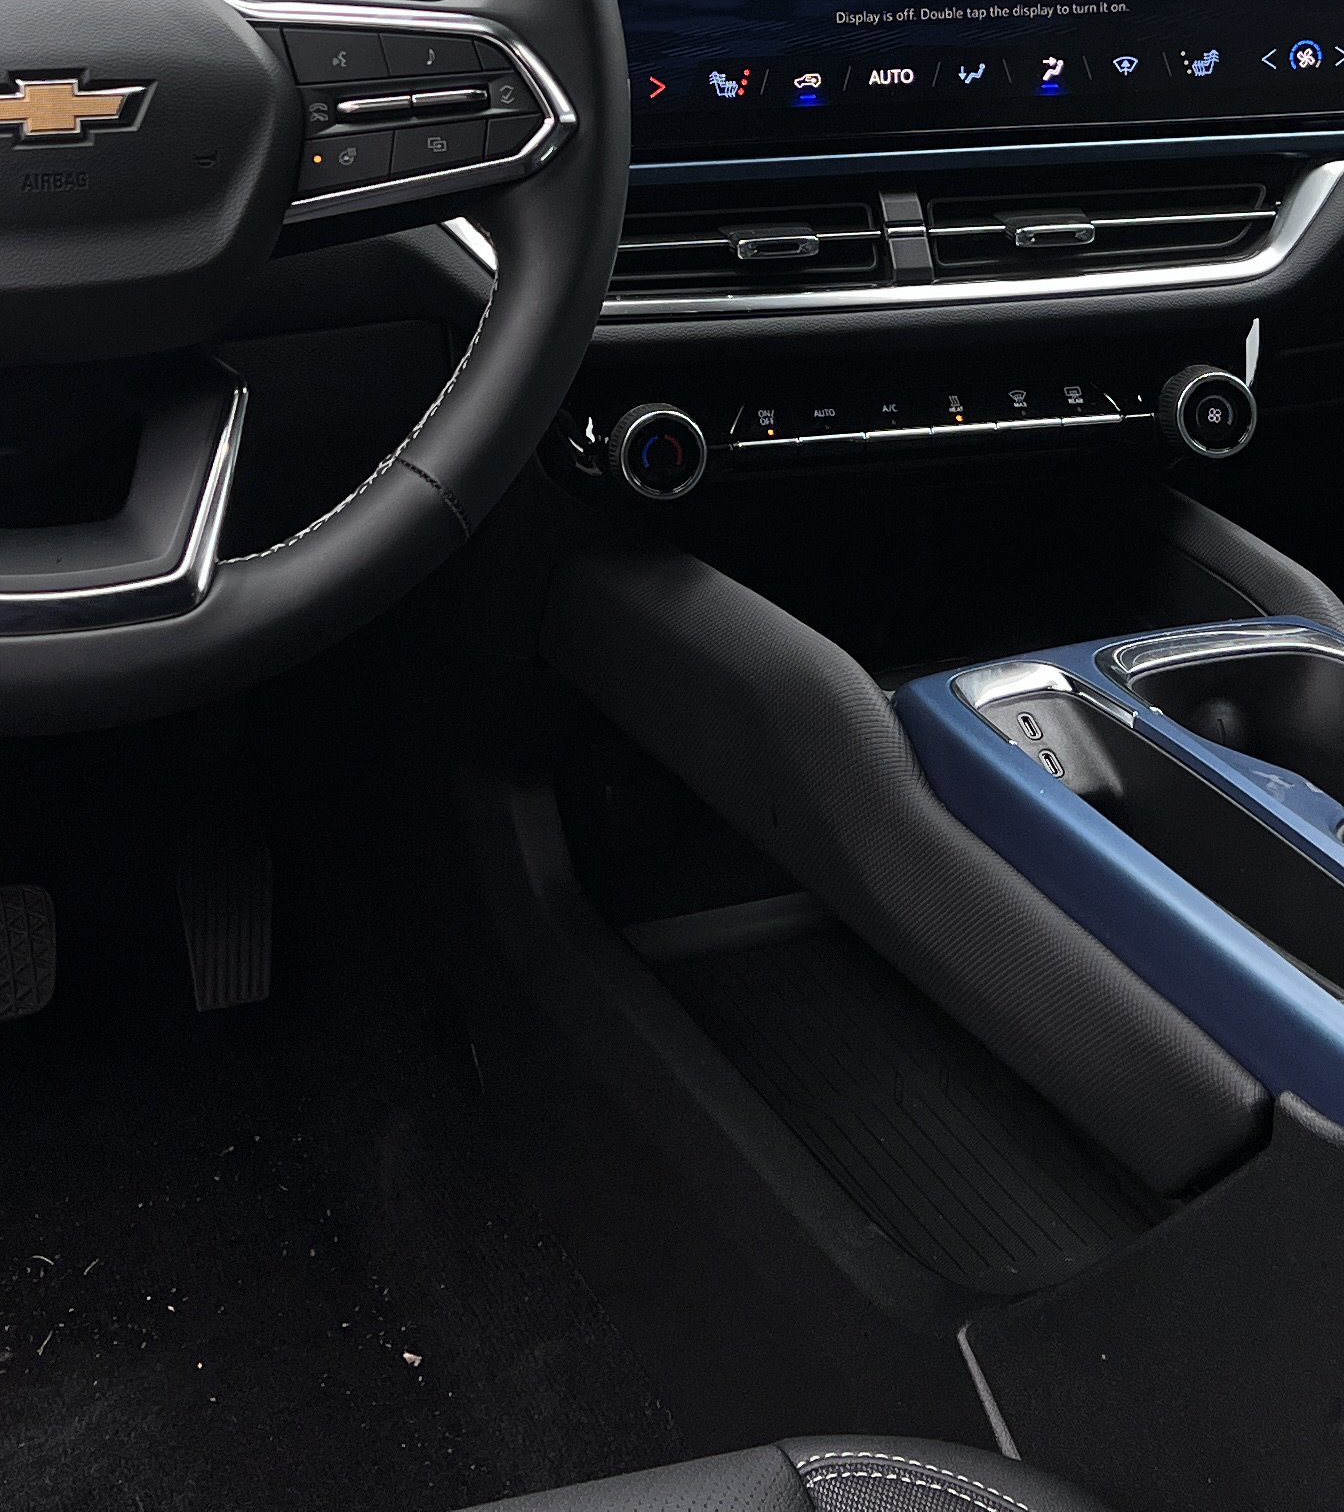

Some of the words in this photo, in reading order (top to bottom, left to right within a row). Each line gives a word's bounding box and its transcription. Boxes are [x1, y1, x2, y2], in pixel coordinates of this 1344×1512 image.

[836, 11, 881, 25] Display
[883, 10, 893, 22] is
[896, 8, 917, 21] off.
[920, 7, 964, 21] Double
[966, 7, 987, 21] tap
[989, 5, 1009, 18] the
[1012, 4, 1054, 19] display
[1056, 3, 1070, 15] to
[1072, 3, 1097, 15] turn
[1099, 1, 1108, 13] it
[1110, 2, 1130, 13] on.
[869, 69, 914, 85] AUTO
[23, 172, 88, 190] AIRBAG
[814, 408, 836, 418] AUTO
[882, 403, 898, 413] A/C
[758, 409, 775, 419] ON/
[760, 417, 774, 426] OFF
